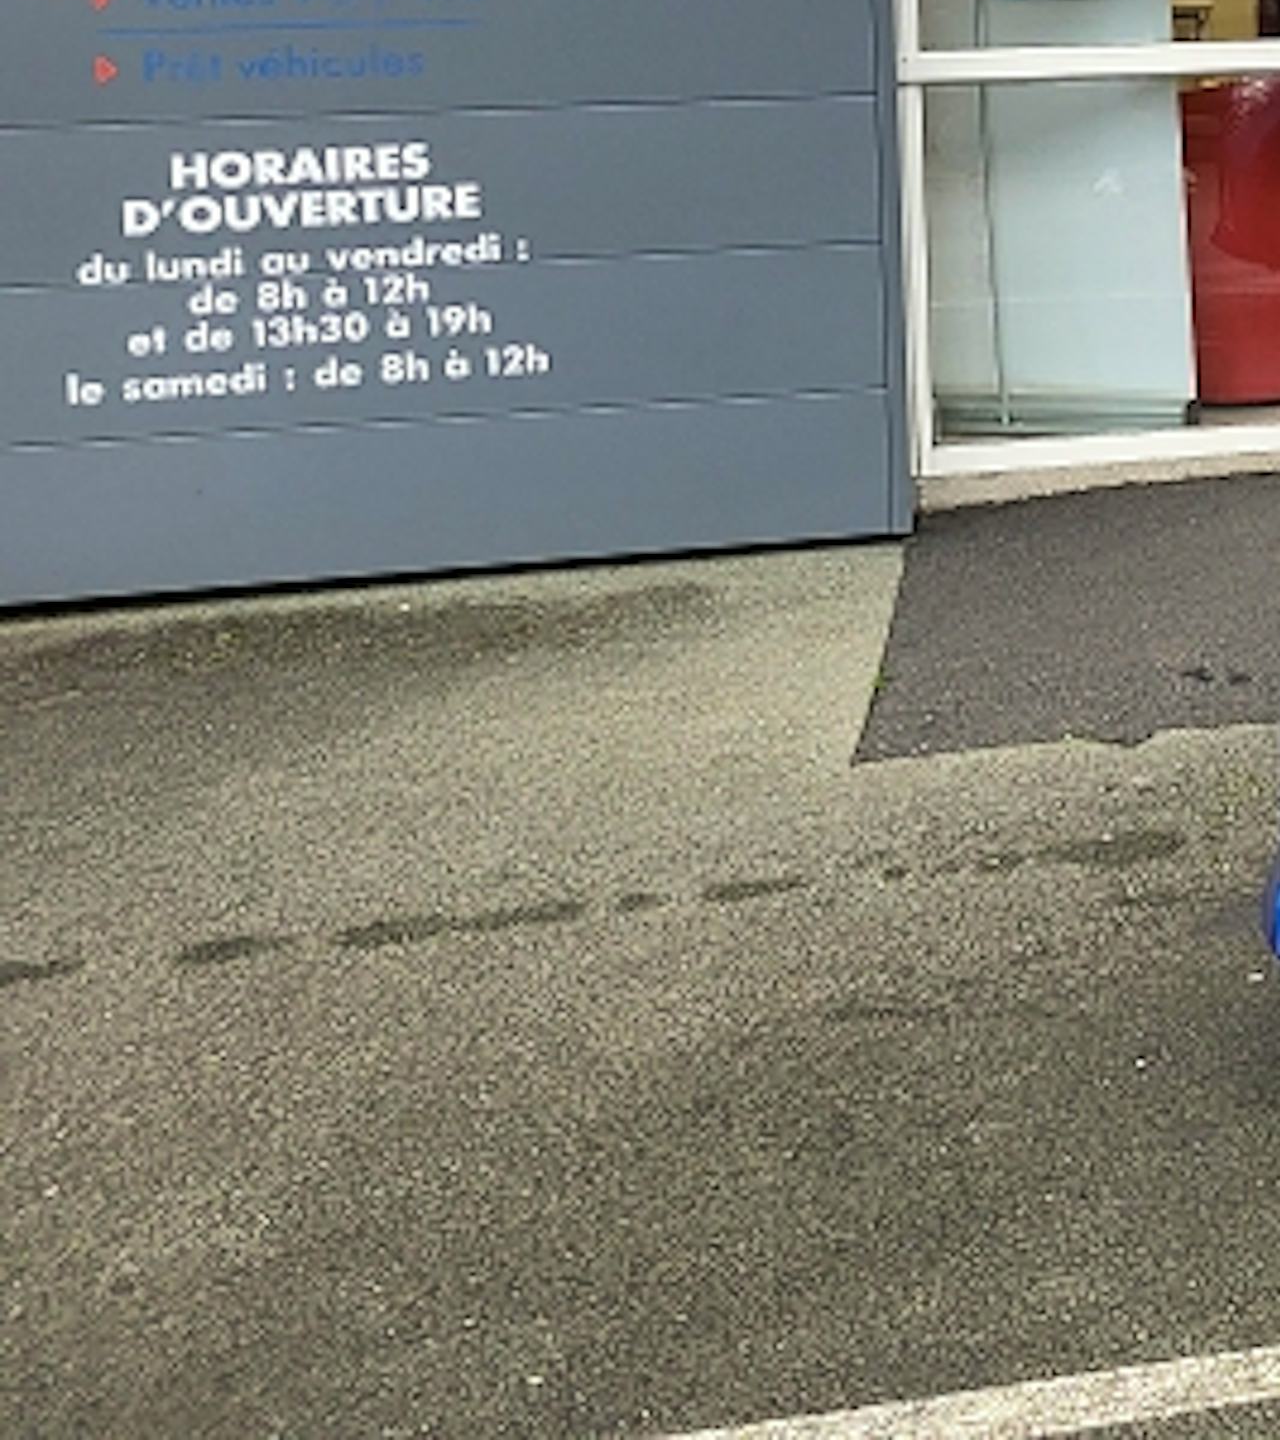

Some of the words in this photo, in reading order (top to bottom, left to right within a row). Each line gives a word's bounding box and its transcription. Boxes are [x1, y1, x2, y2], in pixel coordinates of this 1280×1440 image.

[169, 142, 432, 190] HORAIRES
[121, 182, 482, 238] D'OUVERTURE
[77, 253, 130, 286] du
[146, 248, 245, 282] lundi
[261, 251, 310, 276] au
[325, 233, 502, 272] vendredi
[188, 283, 239, 316] de
[256, 281, 308, 313] 8h
[323, 279, 349, 307] à
[363, 274, 431, 306] 12h
[126, 326, 166, 358] et
[184, 322, 234, 354] de
[252, 312, 370, 350] 13h30
[385, 309, 412, 340] à
[428, 304, 494, 339] 19h
[66, 374, 104, 406] le
[122, 363, 268, 404] samedi
[314, 356, 363, 389] de
[380, 351, 430, 384] 8h
[444, 348, 471, 378] à
[486, 343, 550, 376] 12h
